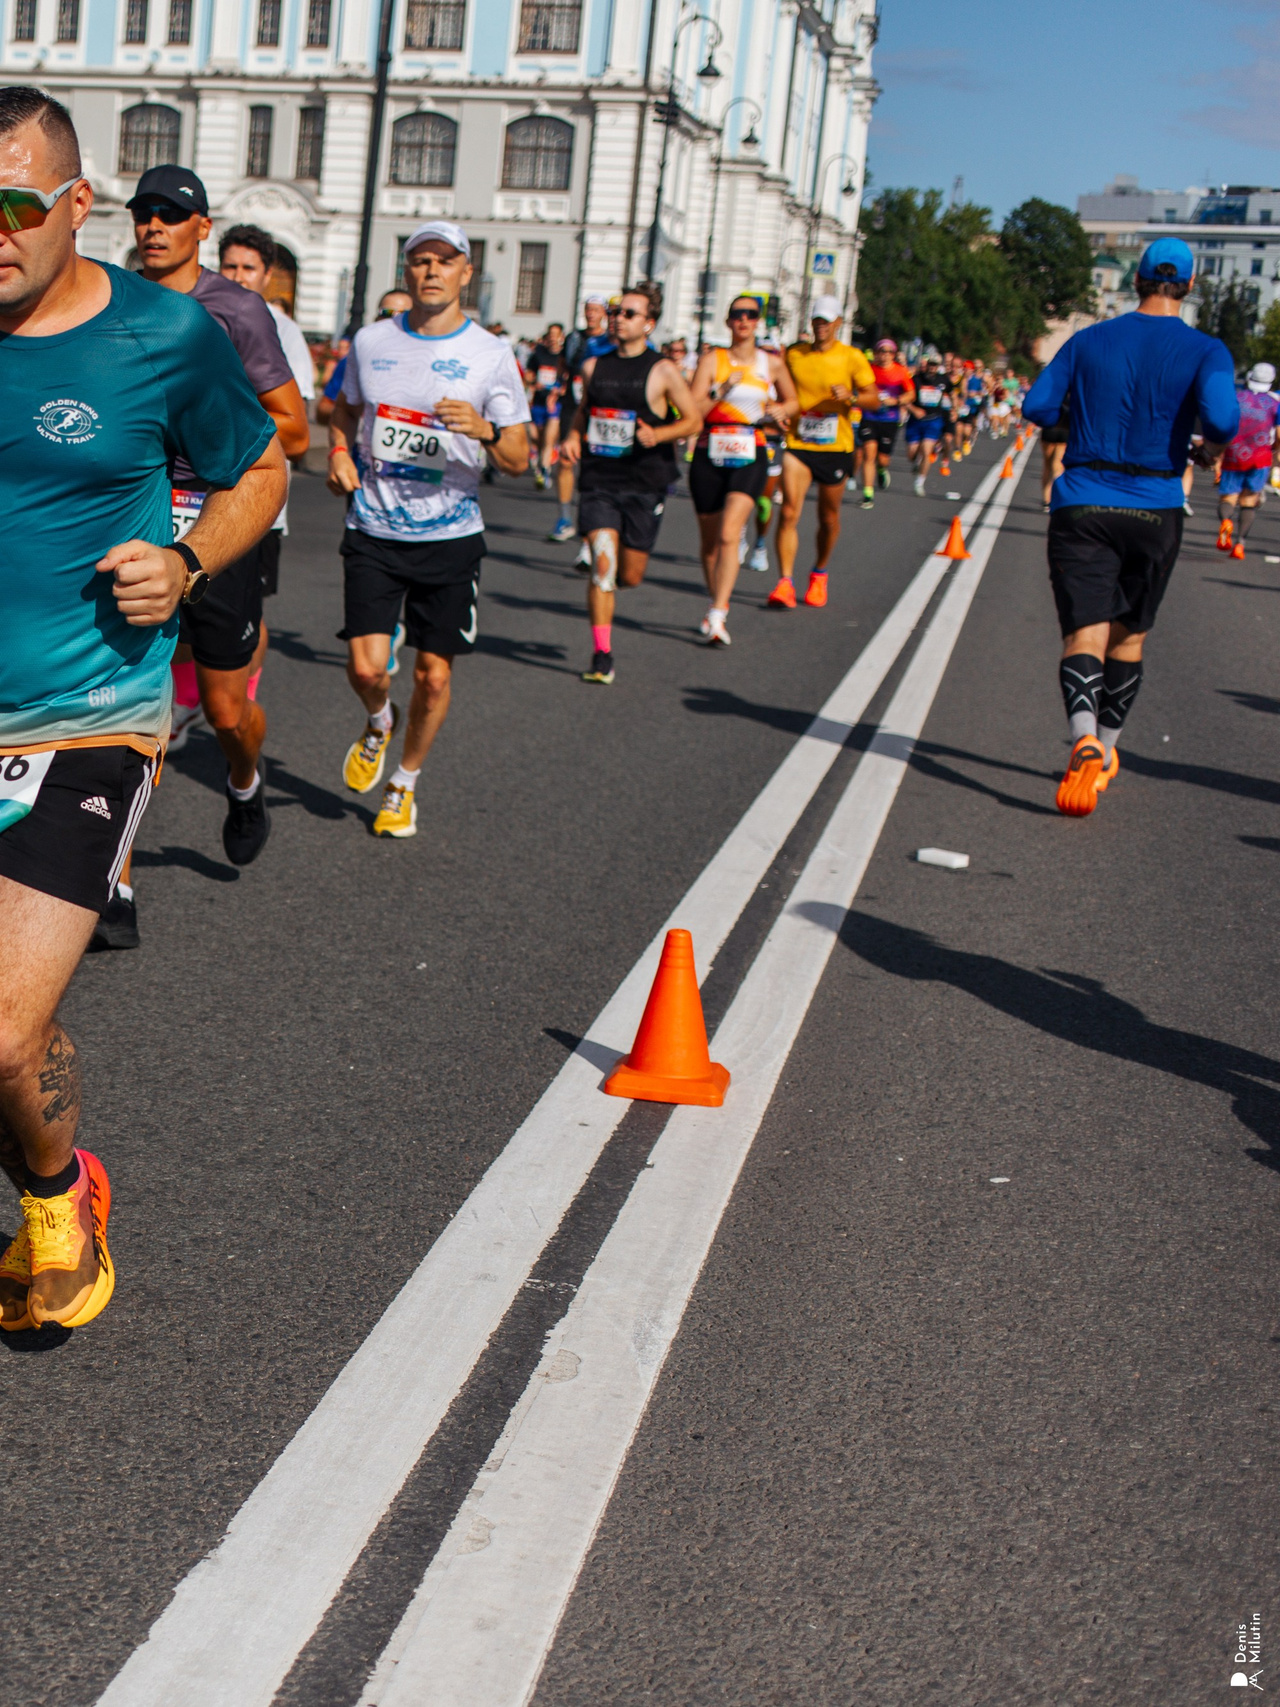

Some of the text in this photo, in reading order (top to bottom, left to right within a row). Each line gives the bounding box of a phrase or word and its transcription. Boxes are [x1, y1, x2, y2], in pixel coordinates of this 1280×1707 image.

[39, 399, 99, 420] GOLDEN RING
[36, 425, 96, 444] ULTRA TRAIL
[381, 426, 439, 457] 3730
[88, 685, 117, 707] GRi
[80, 800, 112, 820] adidas
